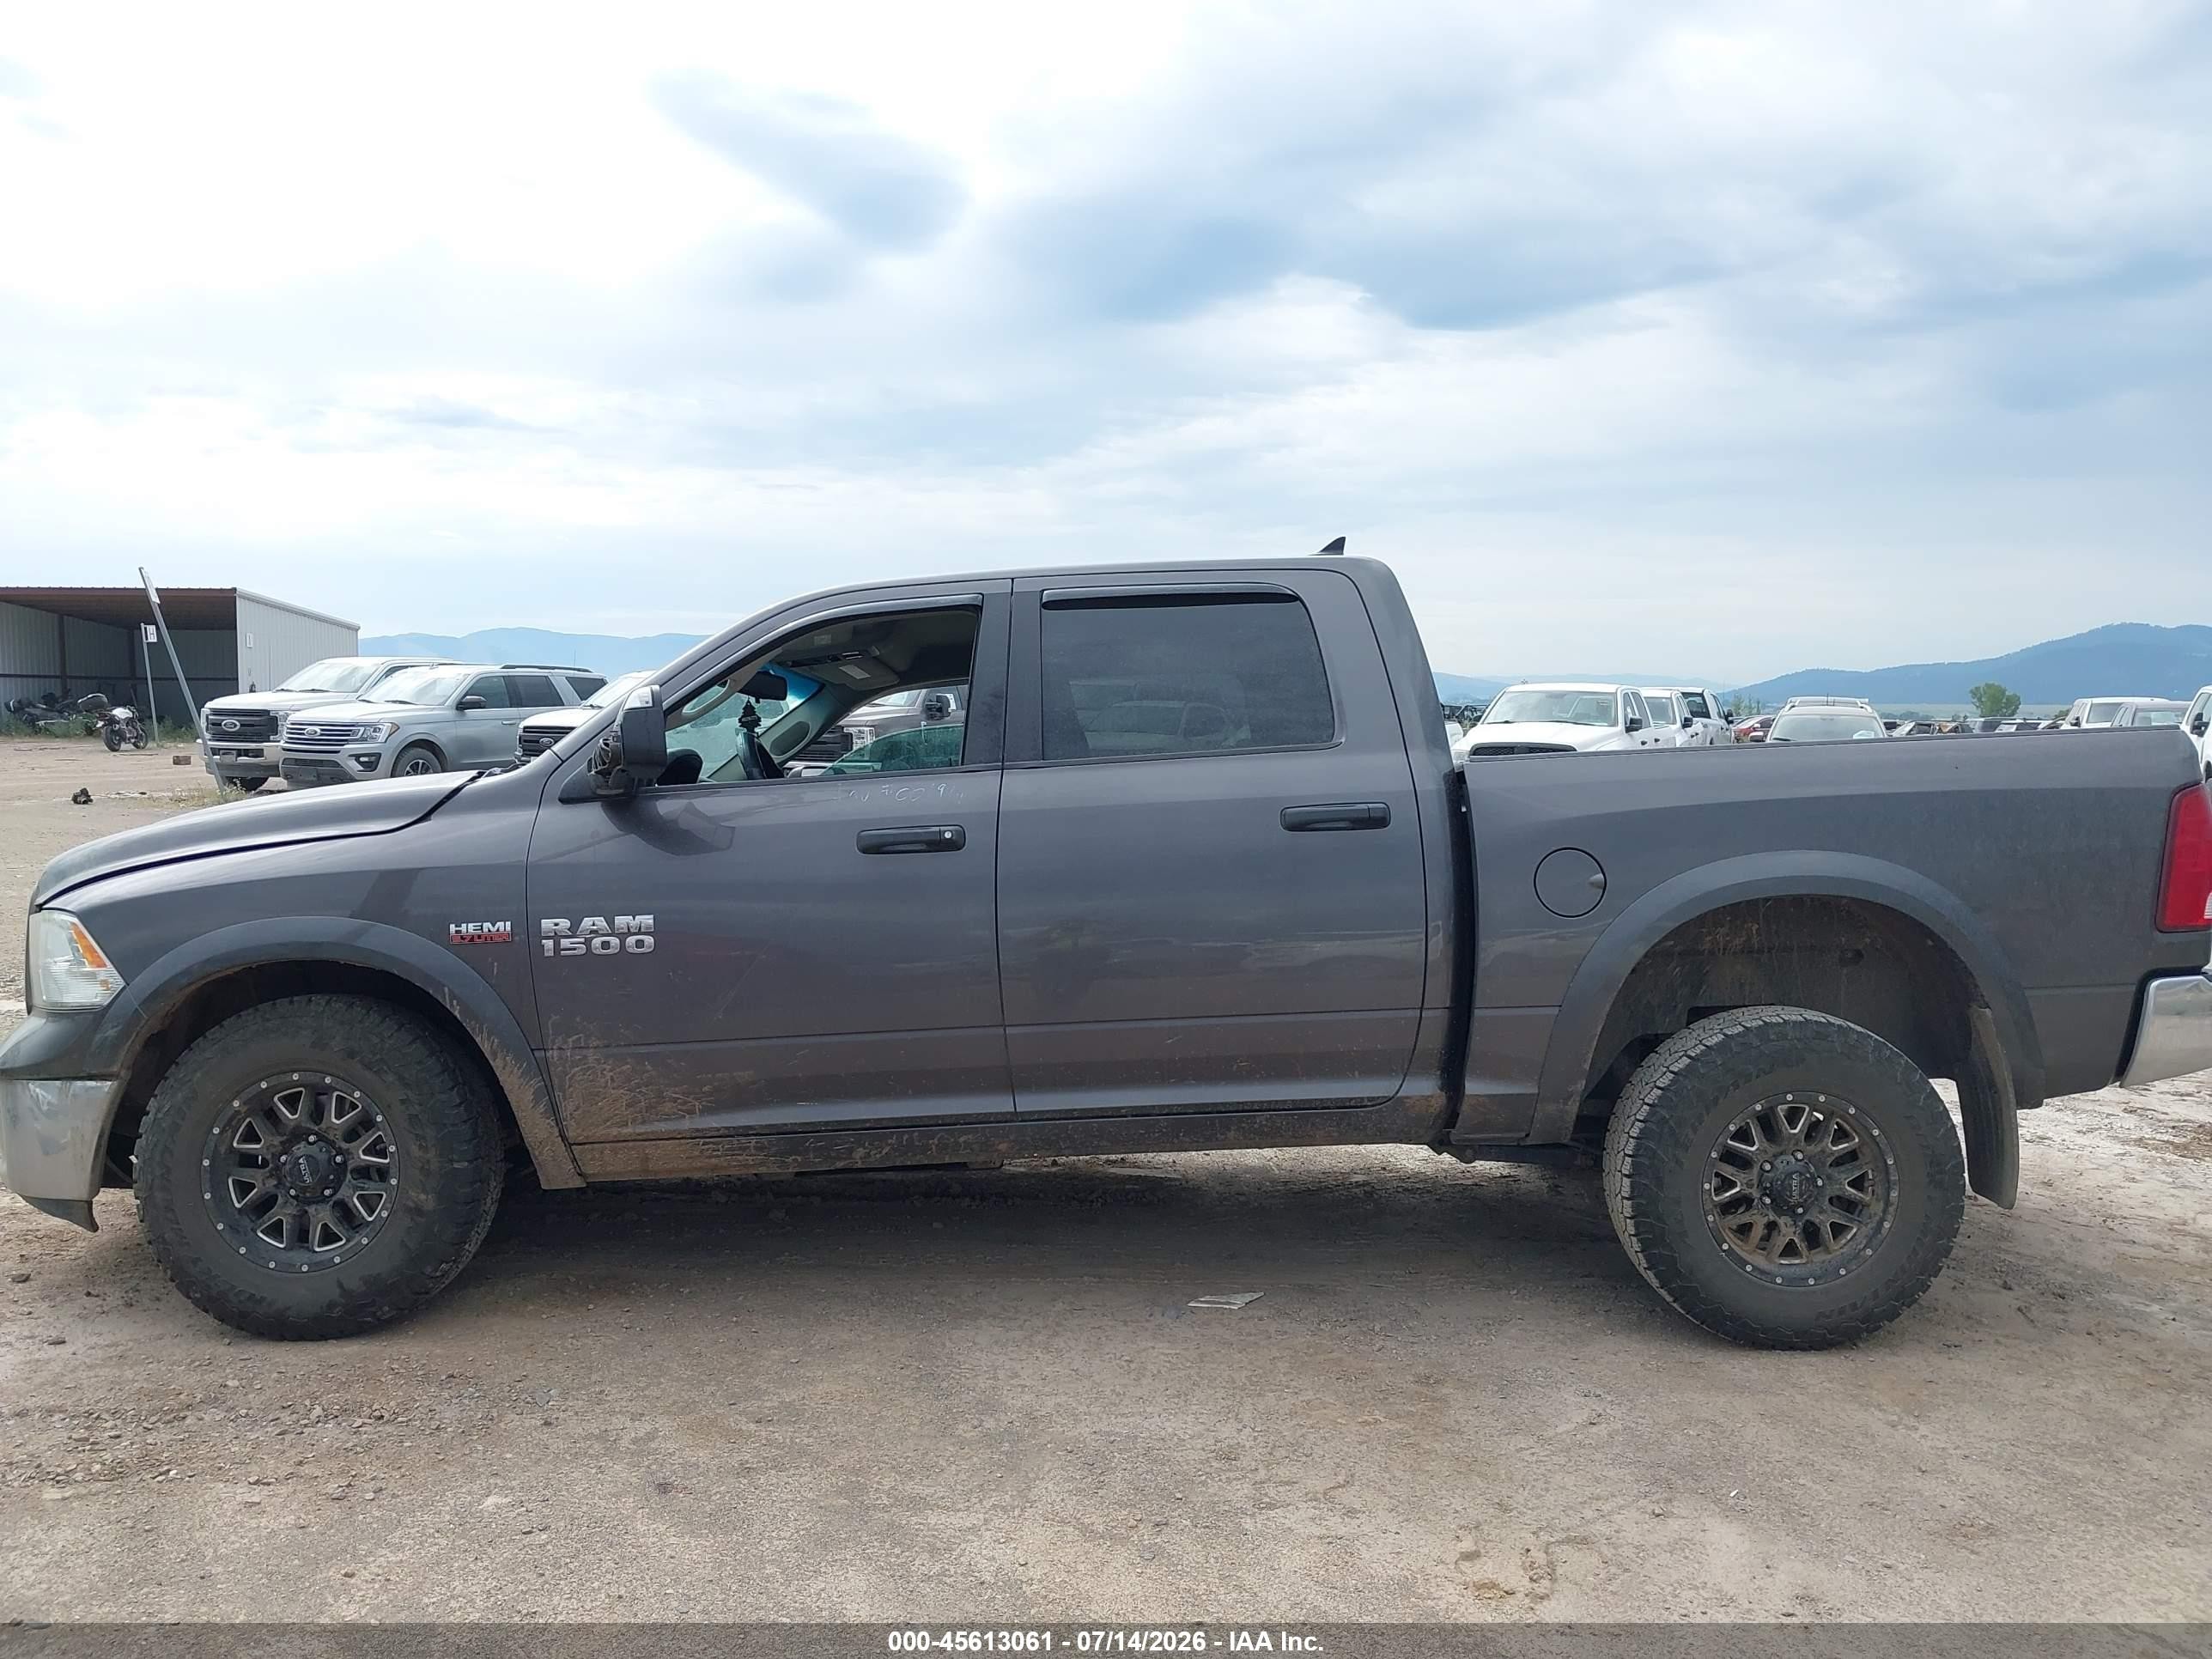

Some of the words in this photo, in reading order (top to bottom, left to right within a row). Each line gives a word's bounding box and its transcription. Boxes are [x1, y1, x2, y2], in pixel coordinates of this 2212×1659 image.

[449, 921, 512, 934] HEMI
[540, 915, 654, 937] RAM
[541, 935, 655, 957] 1500
[298, 1156, 309, 1183] ULTRA
